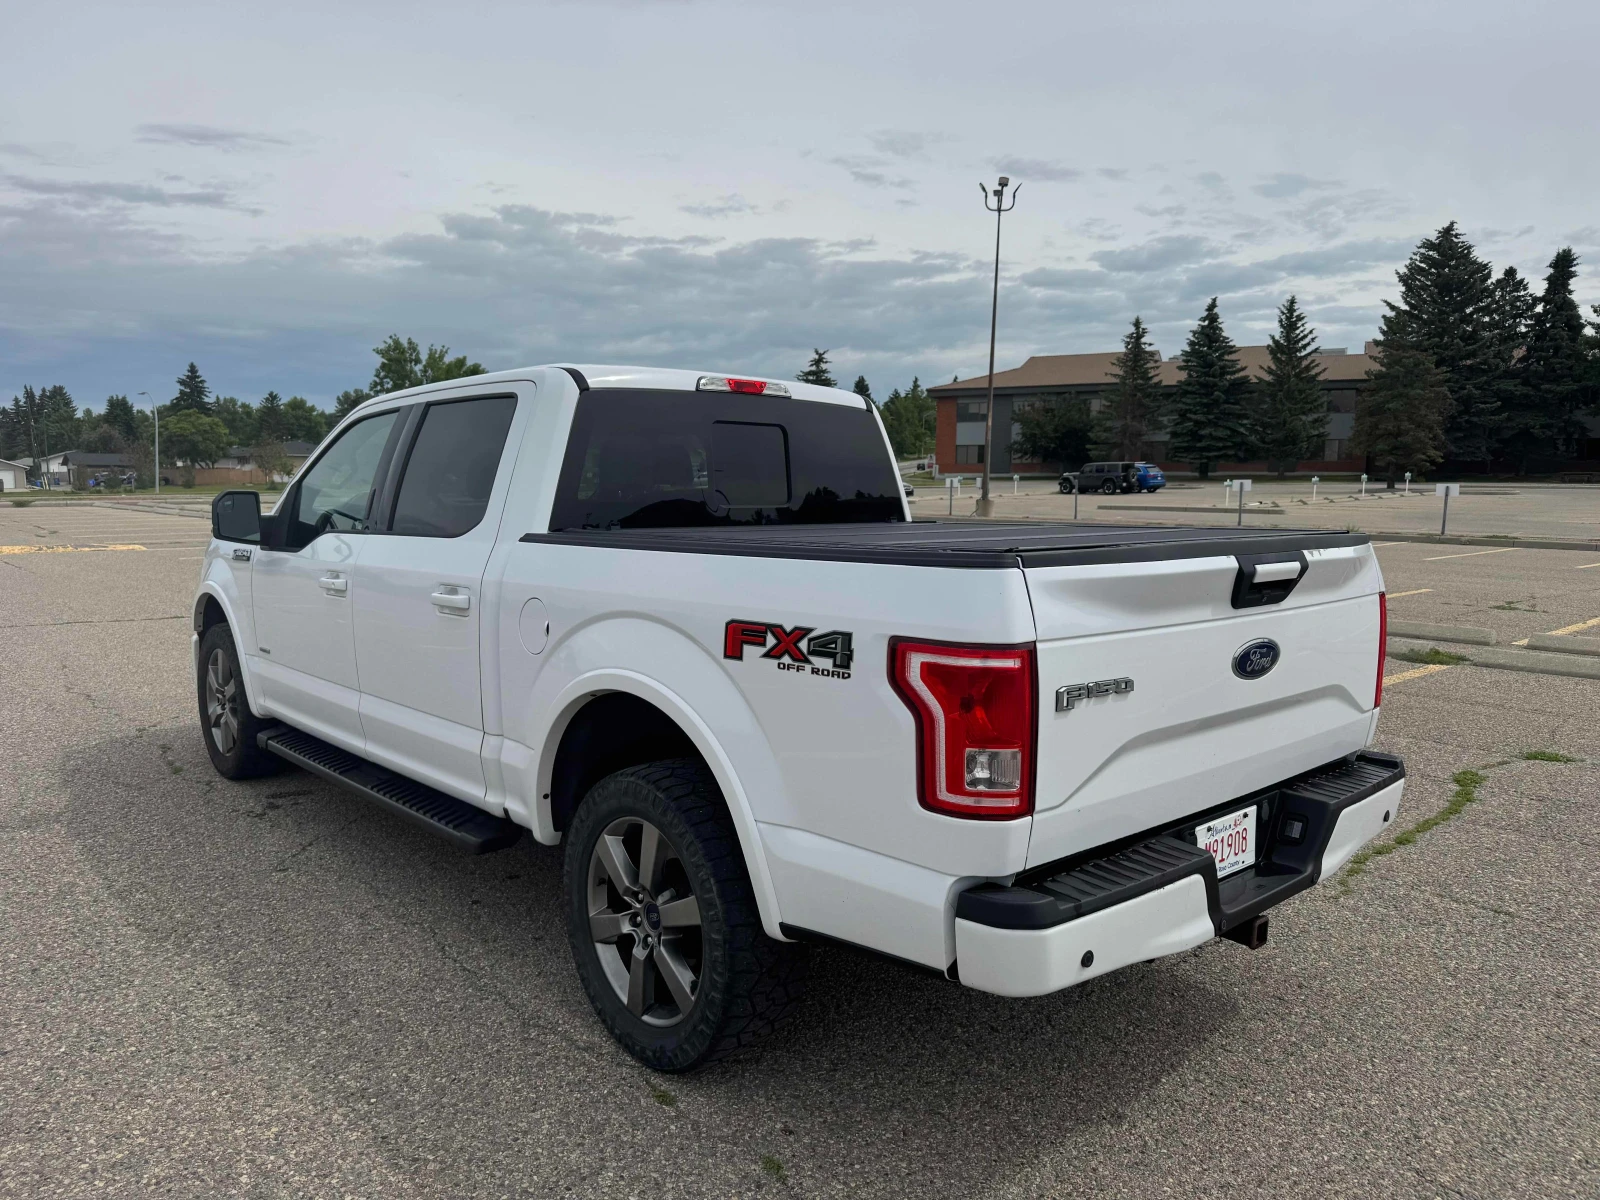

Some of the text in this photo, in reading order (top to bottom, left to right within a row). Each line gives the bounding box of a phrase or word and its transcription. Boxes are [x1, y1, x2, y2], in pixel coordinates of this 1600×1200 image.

[723, 618, 854, 671] FX4
[777, 662, 852, 680] OFF ROAD
[1246, 647, 1273, 672] Ford
